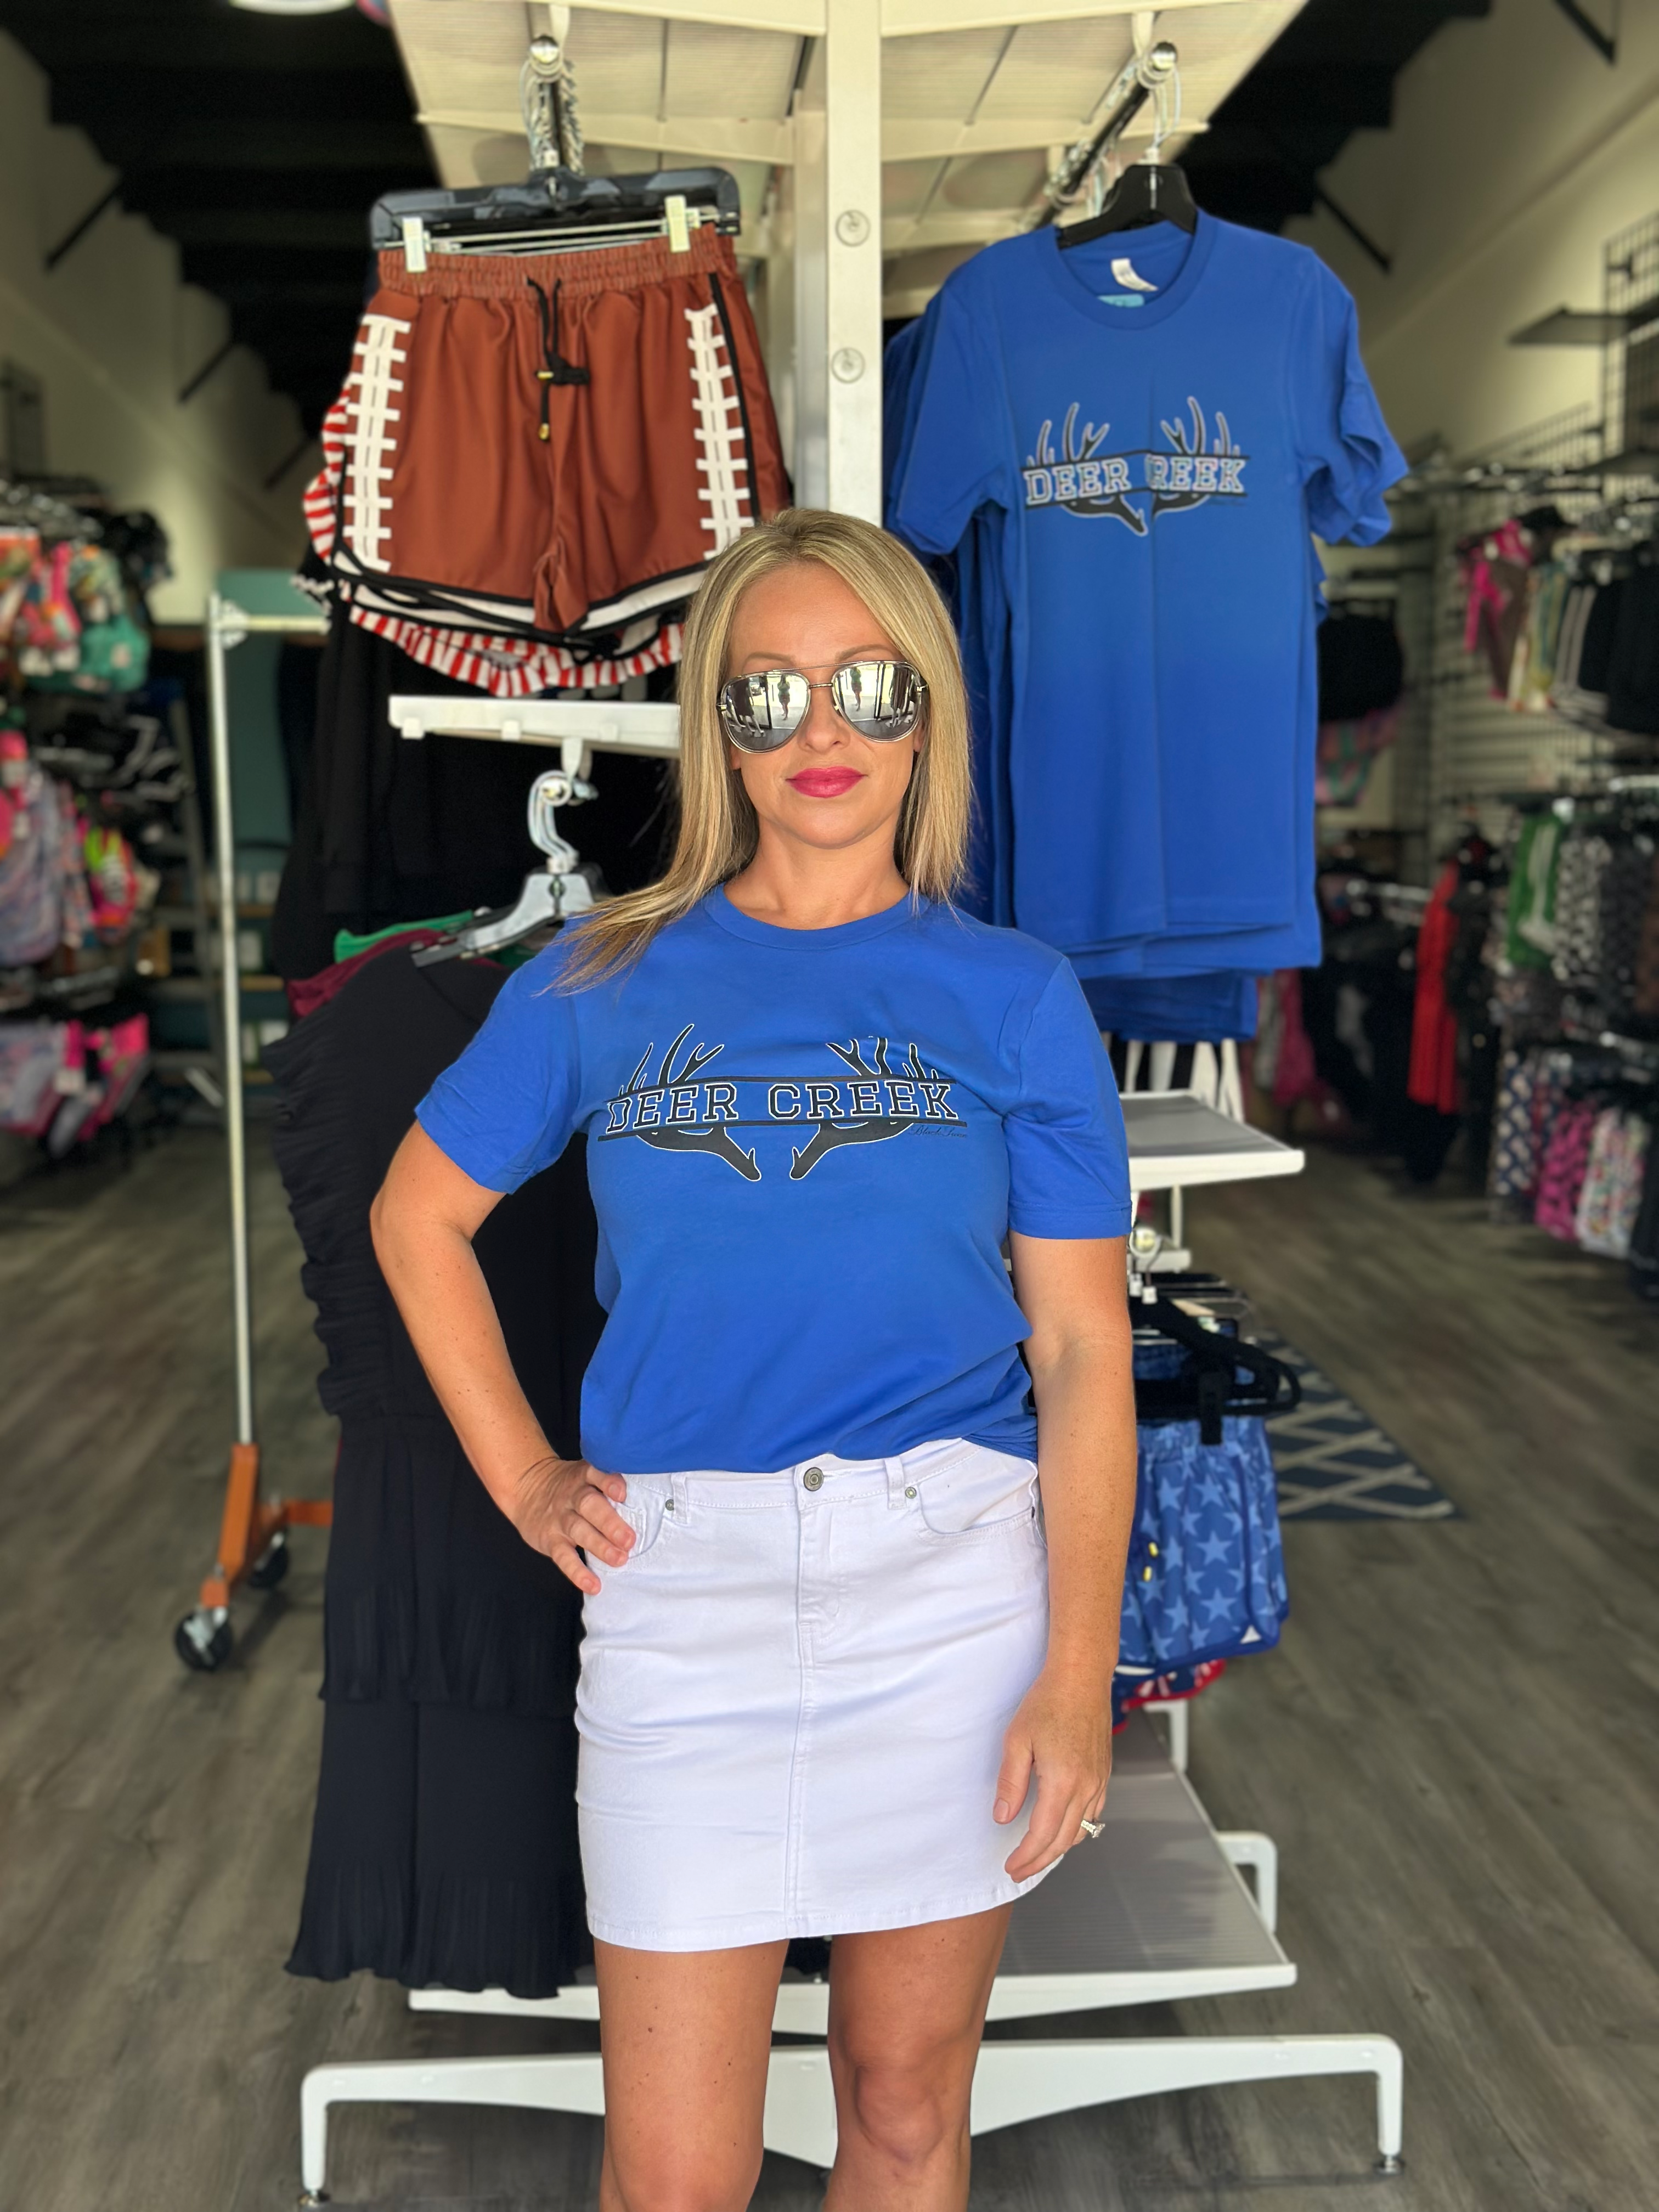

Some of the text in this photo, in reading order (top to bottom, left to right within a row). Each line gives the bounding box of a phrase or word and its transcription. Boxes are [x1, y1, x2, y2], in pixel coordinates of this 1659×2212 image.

[1023, 458, 1132, 505] DEER
[606, 1080, 958, 1134] DEER CREEK
